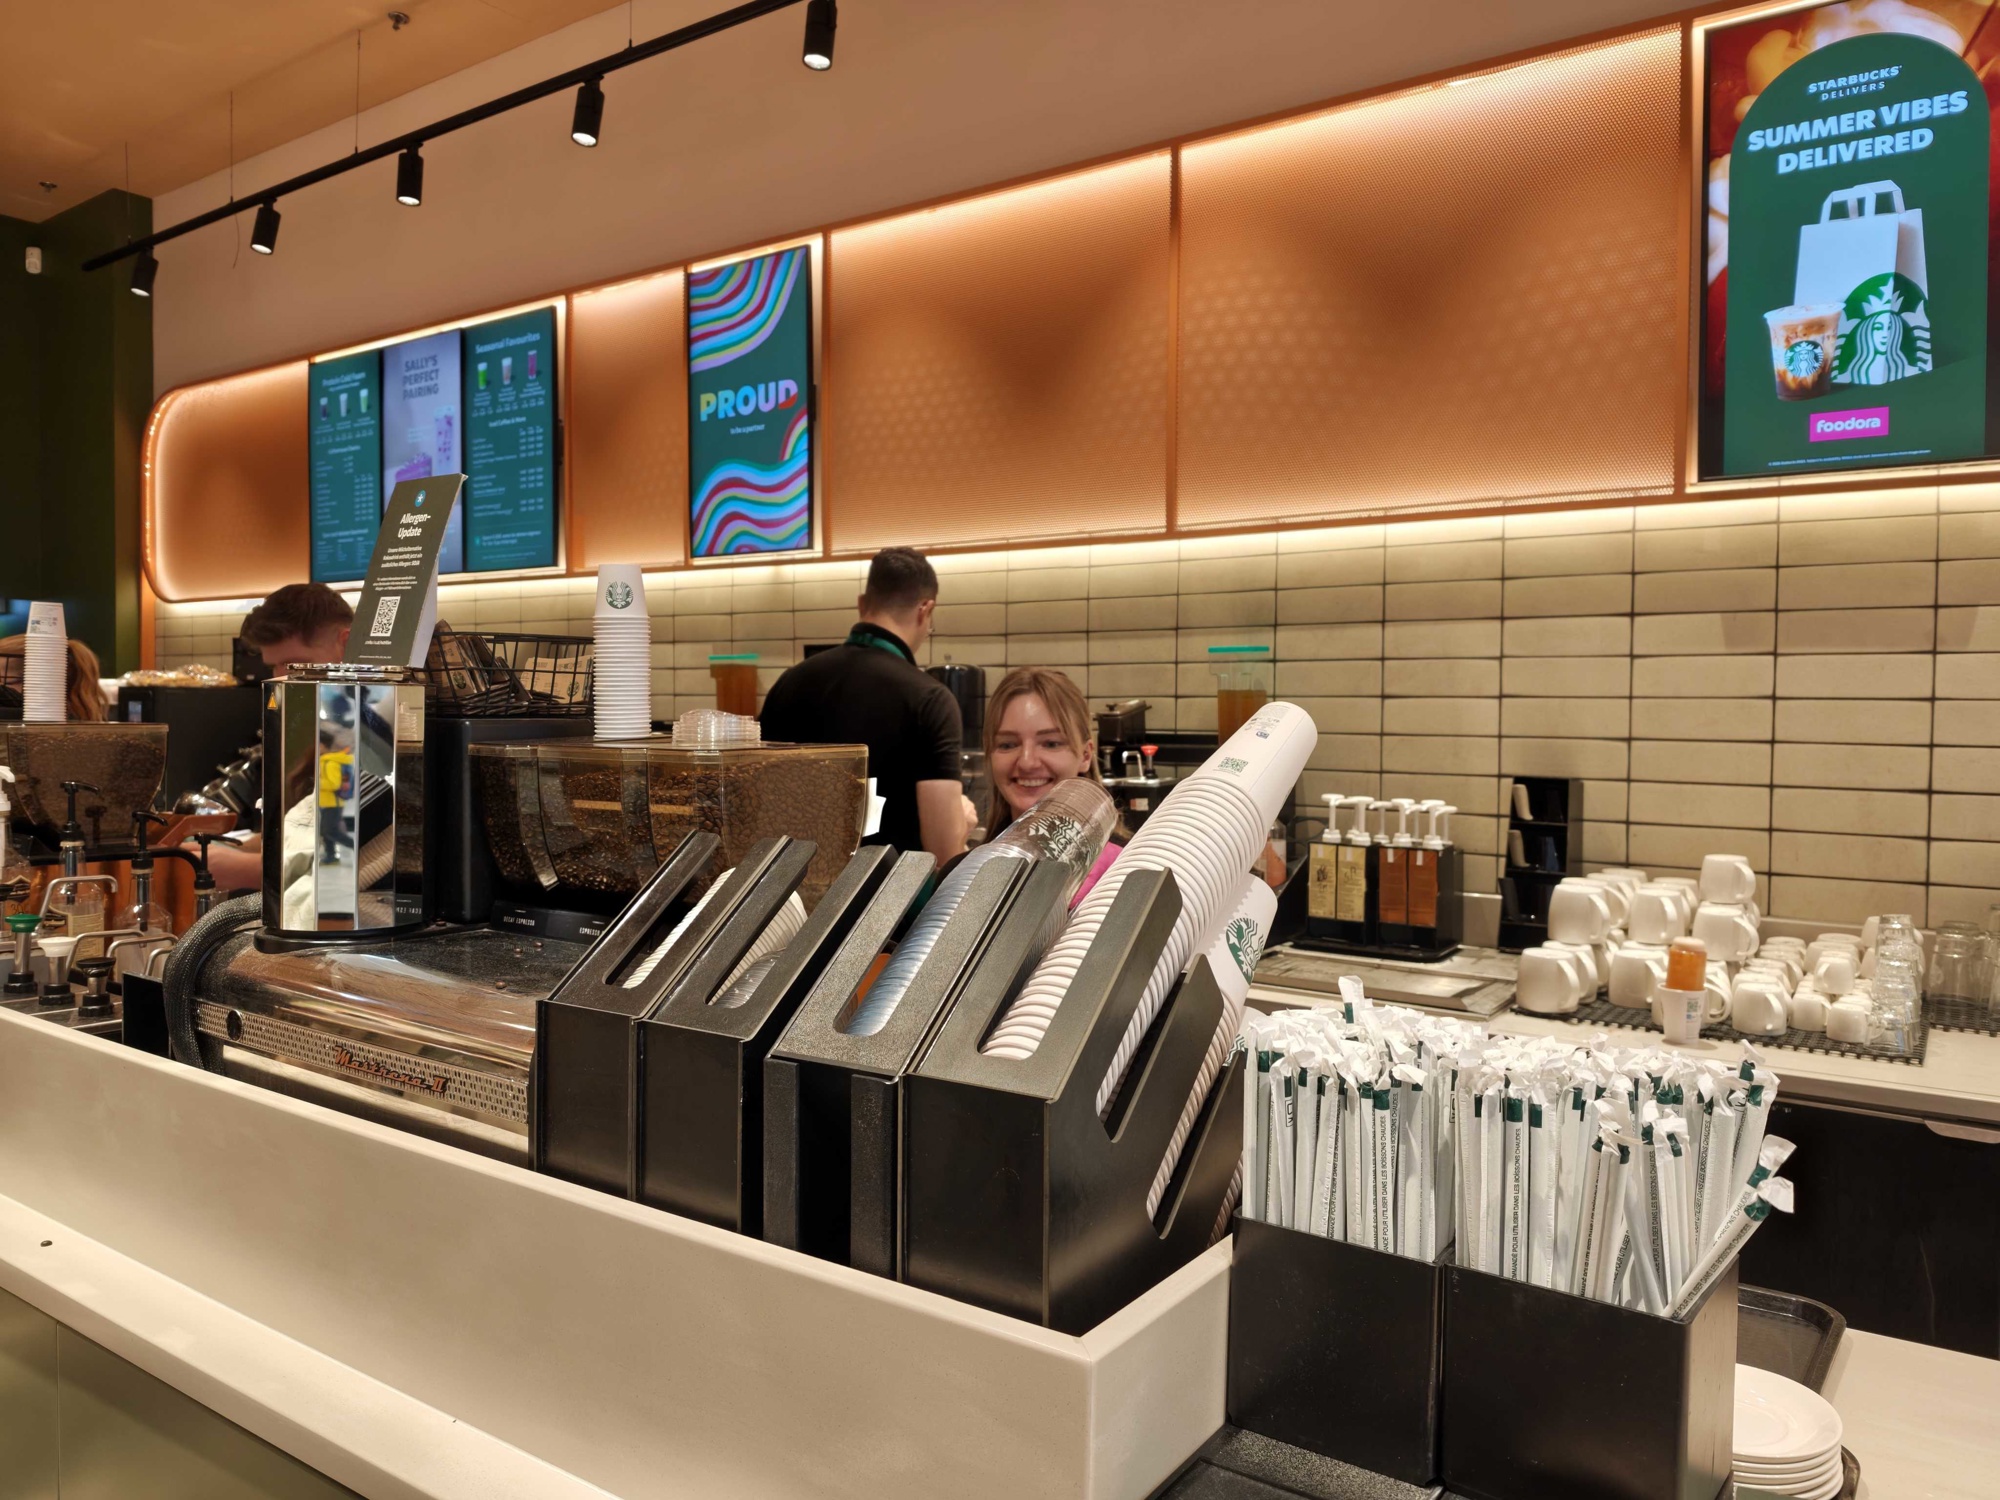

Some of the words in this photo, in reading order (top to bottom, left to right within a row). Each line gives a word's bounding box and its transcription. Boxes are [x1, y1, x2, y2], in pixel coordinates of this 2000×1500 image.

[1808, 65, 1902, 94] STARBUCKS
[1821, 81, 1886, 101] DELIVERS
[1748, 109, 1876, 151] SUMMER
[1880, 90, 1969, 126] VIBES
[1777, 128, 1934, 175] DELIVERED
[404, 354, 438, 373] SALLY'S
[402, 368, 440, 387] PERFECT
[402, 383, 439, 400] PAIRING
[700, 379, 798, 422] PROUD
[1816, 417, 1881, 433] foodora
[400, 513, 431, 525] Allergen-
[398, 526, 422, 540] Update
[332, 1045, 427, 1088] Mastrena
[1619, 1235, 1631, 1257] UTILISER
[1677, 1299, 1690, 1313] POUR
[1686, 1282, 1704, 1302] UTILISER
[1700, 1271, 1713, 1285] DANS
[1709, 1262, 1720, 1273] LES
